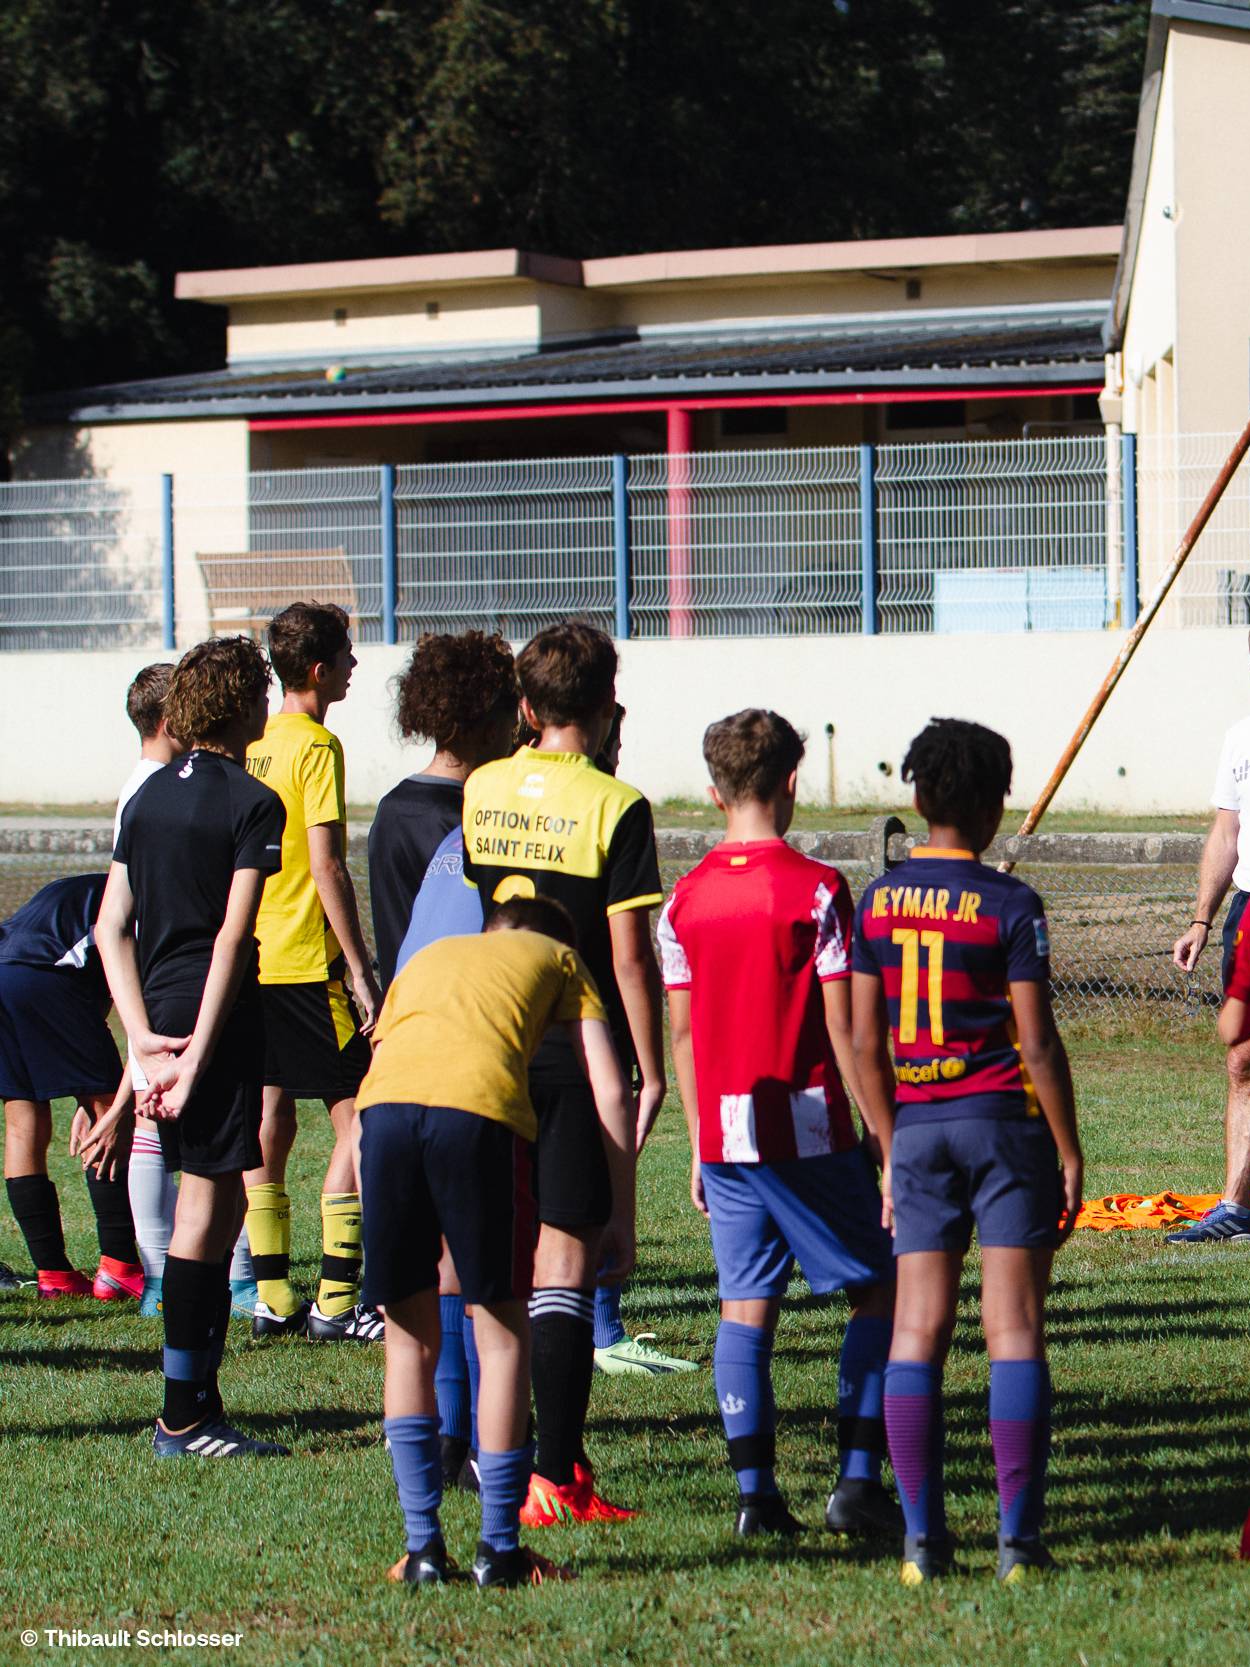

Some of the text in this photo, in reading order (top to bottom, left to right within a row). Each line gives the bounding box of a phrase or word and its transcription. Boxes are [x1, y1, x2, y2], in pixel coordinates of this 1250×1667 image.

[475, 810, 578, 836] OPTION FOOT
[476, 837, 565, 864] SAINT FELIX
[953, 890, 982, 924] JR
[892, 928, 944, 1046] 11
